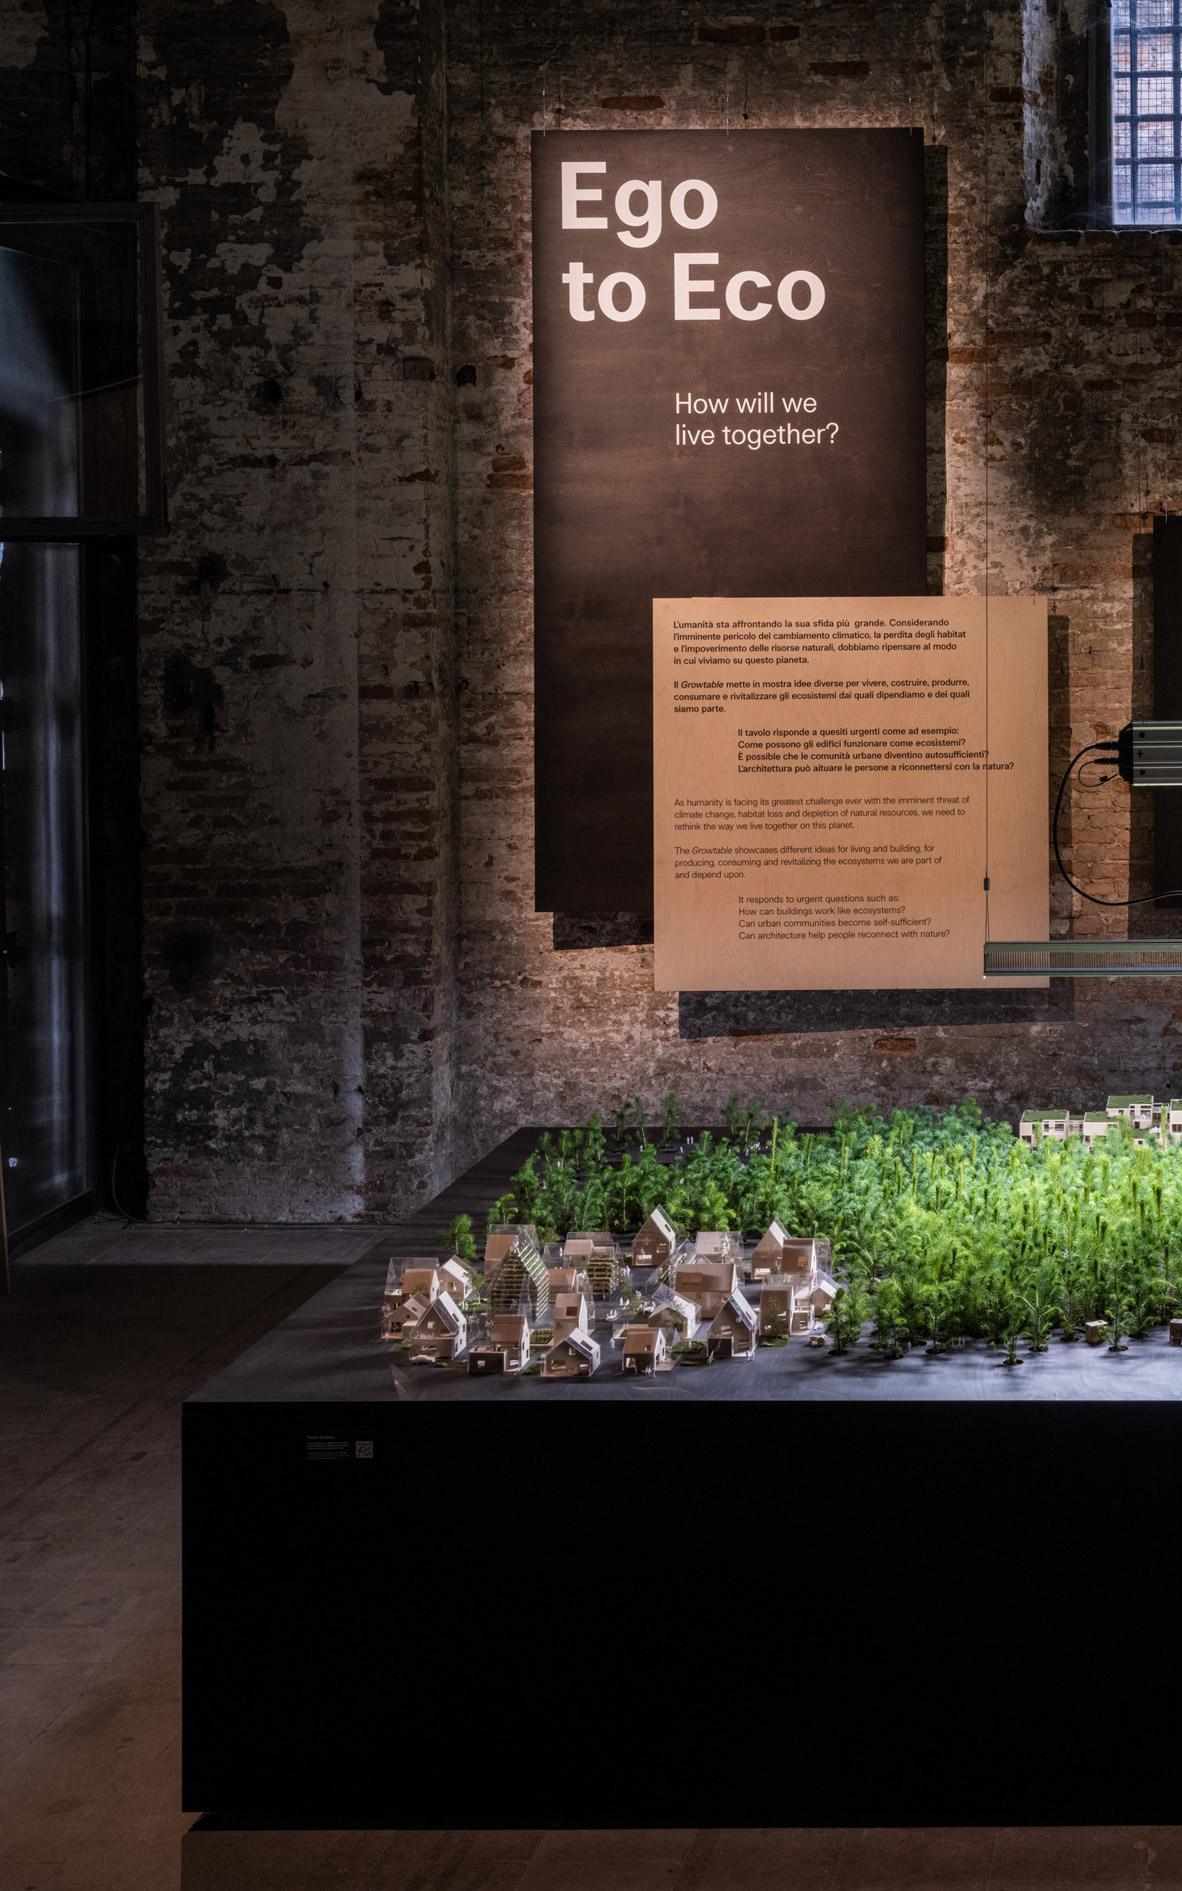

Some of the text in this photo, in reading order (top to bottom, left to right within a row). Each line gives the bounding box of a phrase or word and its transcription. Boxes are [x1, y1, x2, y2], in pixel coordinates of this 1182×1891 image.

[562, 162, 718, 248] Ego
[562, 253, 825, 322] to Eco
[676, 392, 817, 414] How will we
[676, 423, 839, 450] live together?
[732, 620, 783, 628] affrontando
[785, 620, 793, 628] la
[813, 620, 834, 628] sfida
[836, 619, 850, 629] più
[889, 619, 949, 627] Considerando
[723, 632, 757, 642] pericolo
[884, 631, 913, 640] perdita
[914, 630, 935, 640] degli
[937, 630, 966, 638] habitat
[749, 644, 770, 652] delle
[838, 643, 880, 651] dobbiamo
[882, 643, 921, 652] ripensare
[923, 642, 931, 651] al
[674, 657, 682, 665] in
[745, 657, 774, 666] questo
[681, 681, 725, 689] Growtable
[814, 680, 844, 688] diverse
[846, 681, 860, 689] per
[779, 692, 790, 702] gli
[792, 692, 837, 700] ecosistemi
[854, 691, 874, 701] quali
[876, 691, 926, 700] dipendiamo
[934, 690, 948, 698] dei
[950, 690, 970, 700] quali
[745, 729, 771, 737] tavolo
[773, 728, 810, 738] risponde
[820, 728, 848, 738] quesiti
[850, 728, 880, 737] urgenti
[738, 741, 764, 749] Come
[766, 742, 802, 750] possono
[803, 740, 814, 750] gli
[816, 740, 842, 748] edifici
[843, 740, 888, 748] funzionare
[915, 738, 966, 747] ecosistemi?
[674, 822, 702, 831] rethink
[750, 822, 764, 830] live
[765, 822, 798, 832] together
[812, 821, 827, 829] this
[675, 871, 690, 879] and
[692, 871, 722, 880] depend
[746, 896, 784, 905] responds
[796, 896, 823, 905] urgent
[825, 895, 865, 904] questions
[866, 894, 886, 902] such
[739, 908, 758, 916] How
[777, 907, 813, 917] buildings
[815, 907, 836, 915] work
[837, 907, 852, 915] like
[853, 906, 906, 916] ecosystems?
[739, 919, 756, 928] Can
[758, 920, 782, 928] urban
[783, 919, 836, 927] communities
[874, 918, 932, 926] self-sufficient?
[739, 932, 756, 940] Can
[758, 932, 807, 940] architecture
[808, 931, 826, 940] help
[828, 931, 856, 940] people
[901, 930, 919, 938] with
[920, 929, 951, 938] nature?
